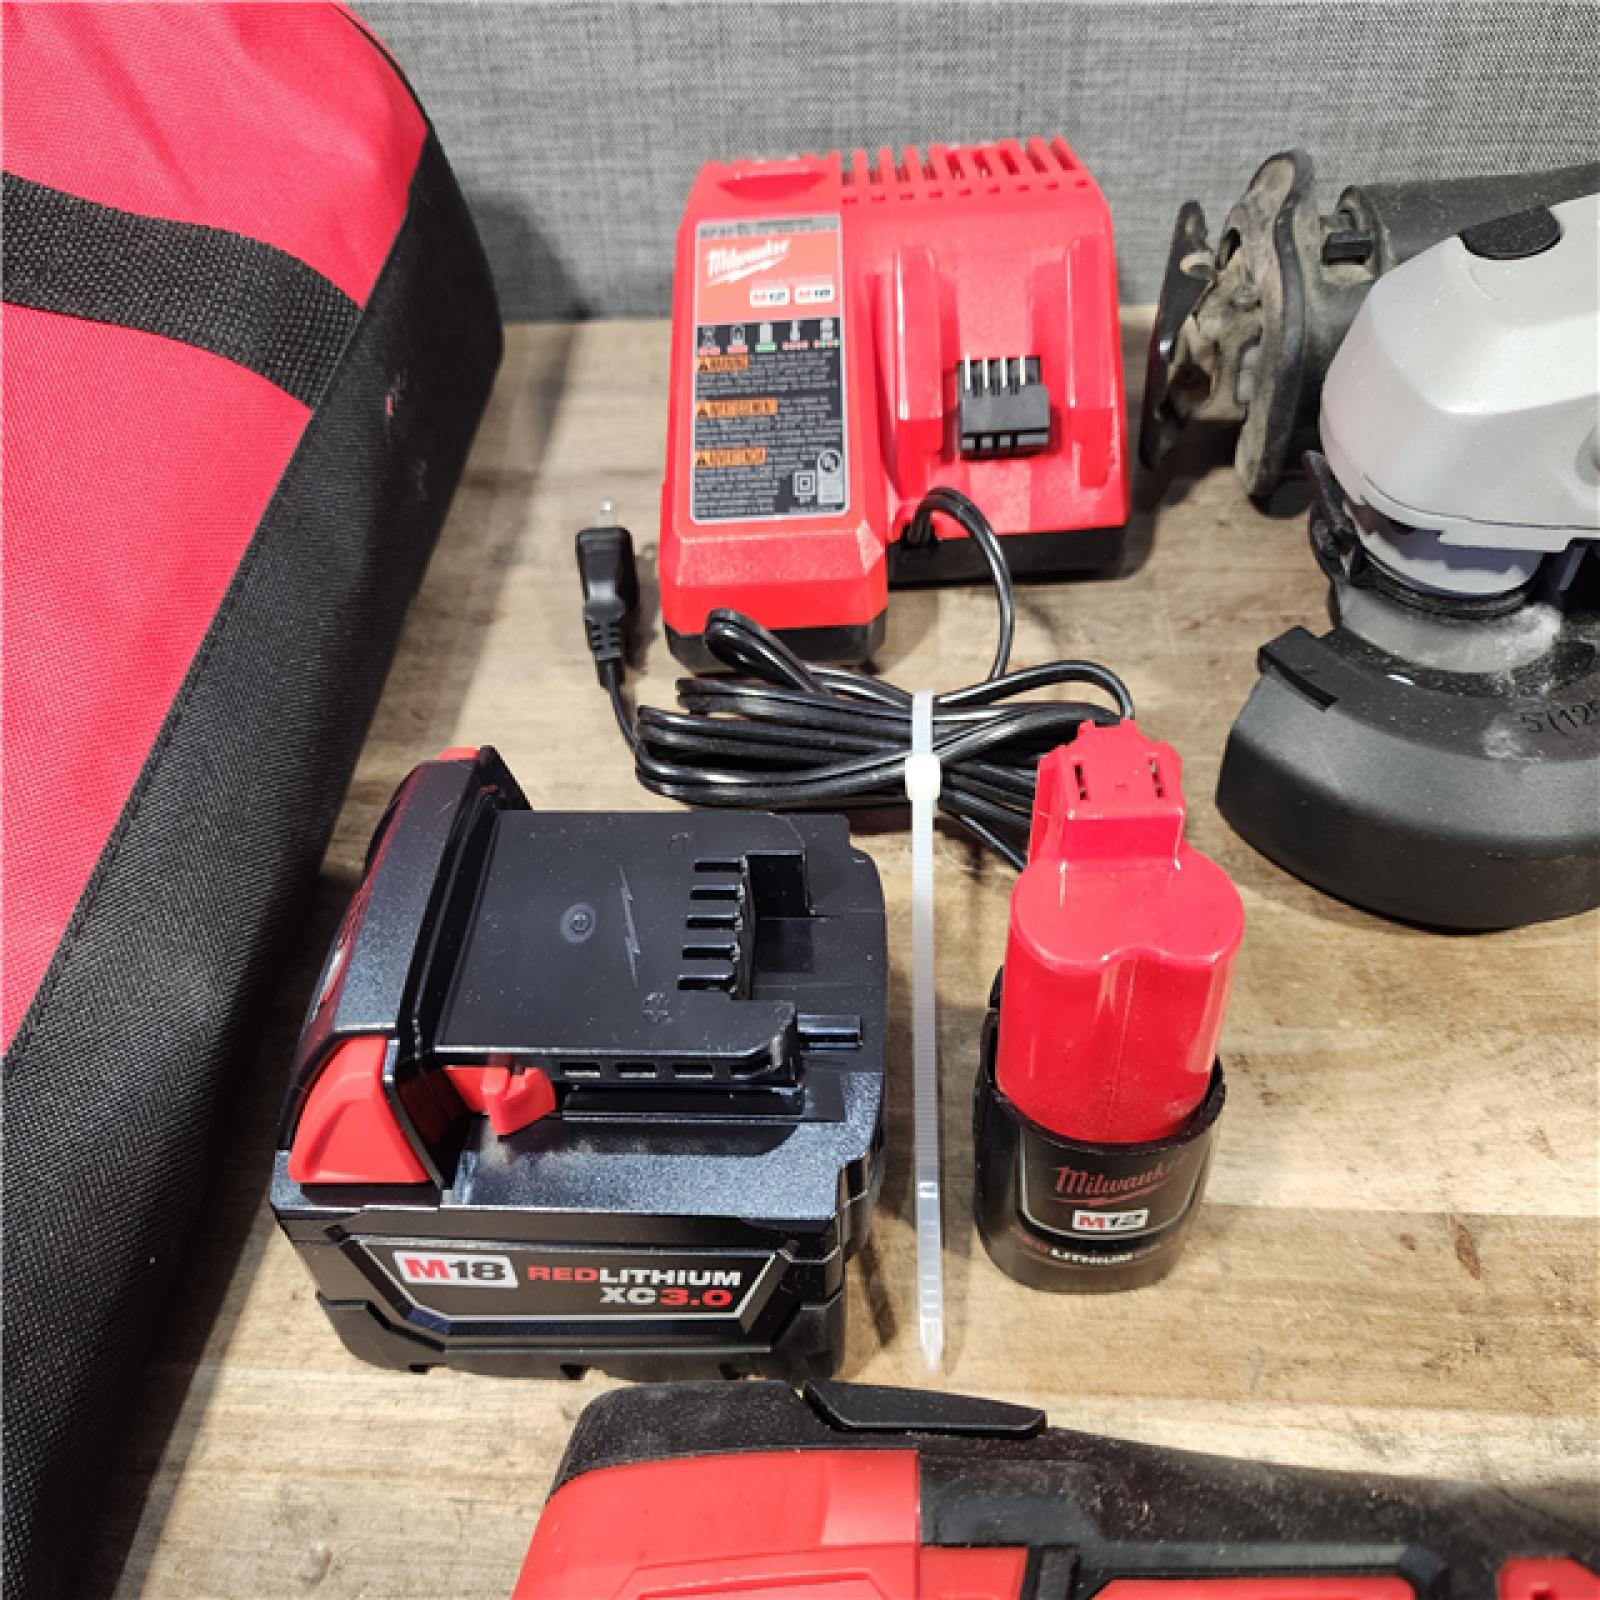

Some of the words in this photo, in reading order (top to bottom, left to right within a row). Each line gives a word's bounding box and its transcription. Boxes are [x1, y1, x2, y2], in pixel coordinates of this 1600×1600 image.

[404, 1257, 507, 1281] M18
[527, 1265, 742, 1287] REDLITHIUM
[600, 1286, 657, 1305] XC
[659, 1288, 733, 1307] 3.0
